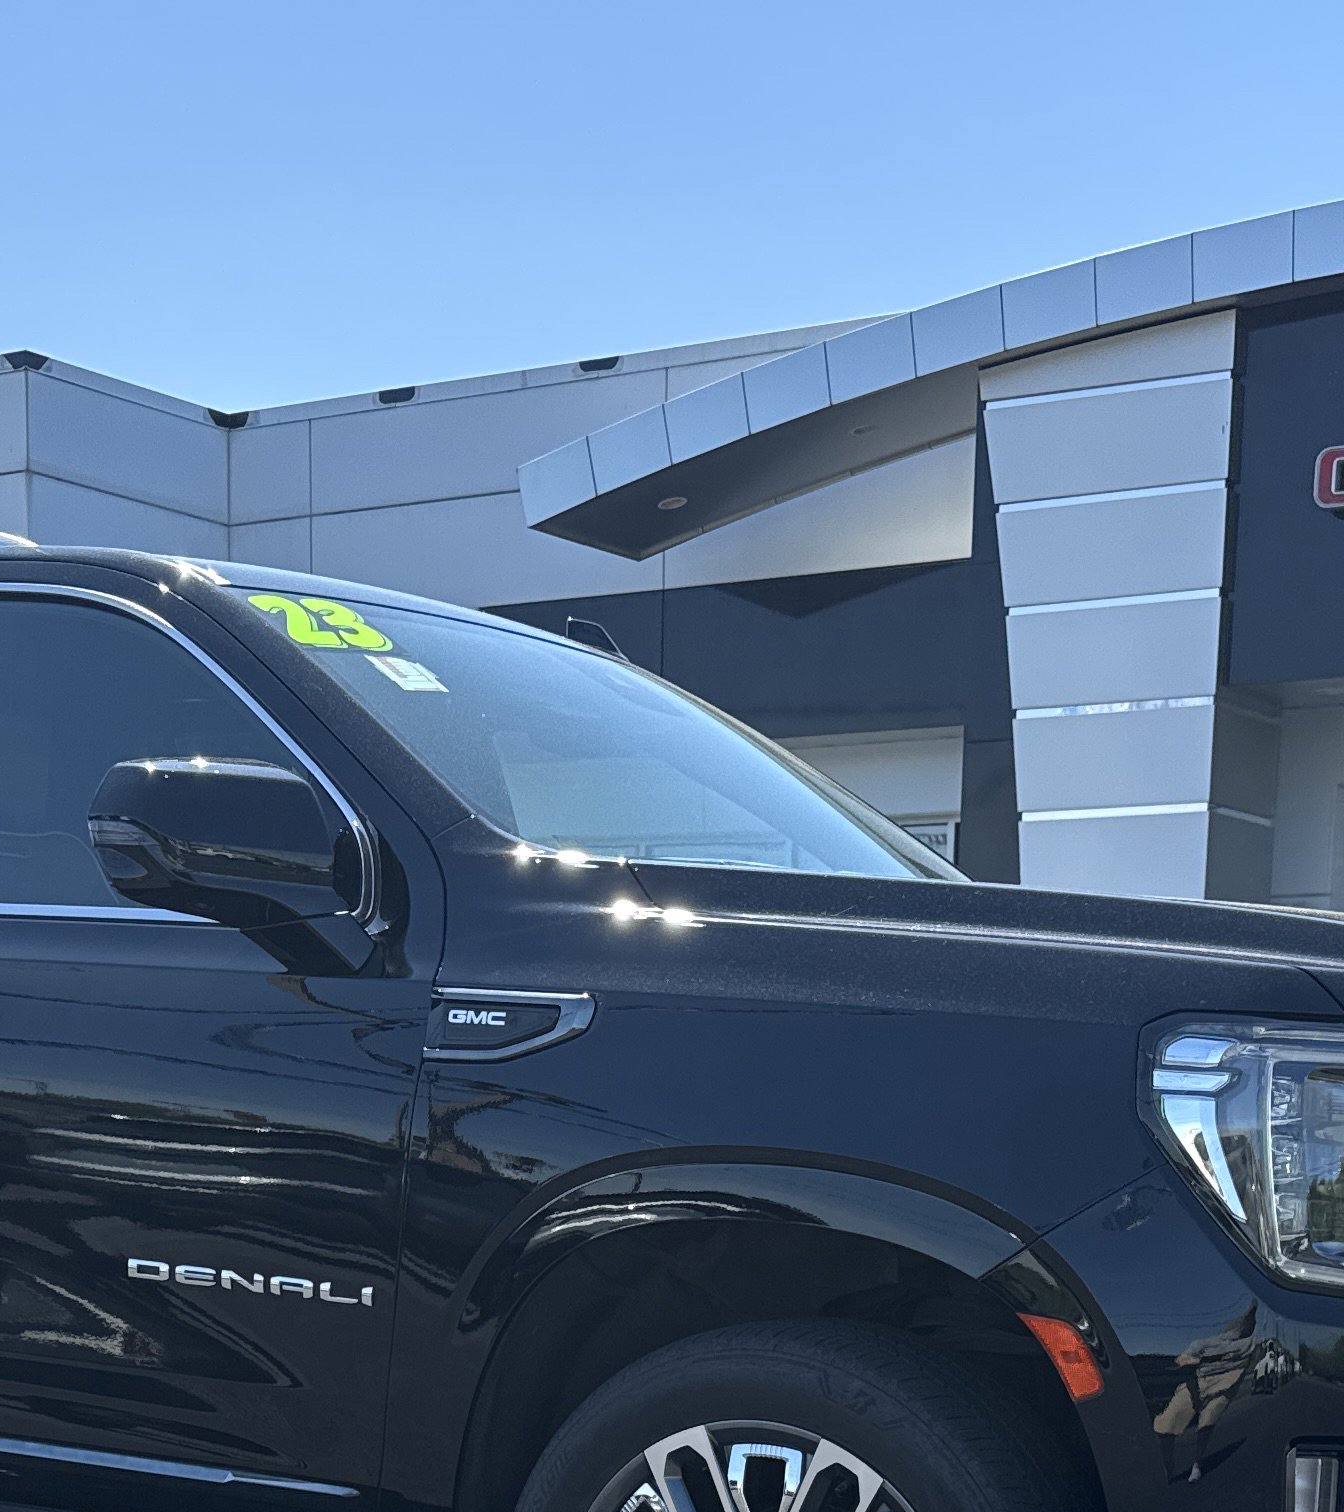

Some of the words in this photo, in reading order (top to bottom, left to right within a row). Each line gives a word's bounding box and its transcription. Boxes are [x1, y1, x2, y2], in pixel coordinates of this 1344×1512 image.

[247, 595, 394, 652] 23
[447, 1009, 507, 1026] GMC
[127, 1258, 374, 1307] DENALI
